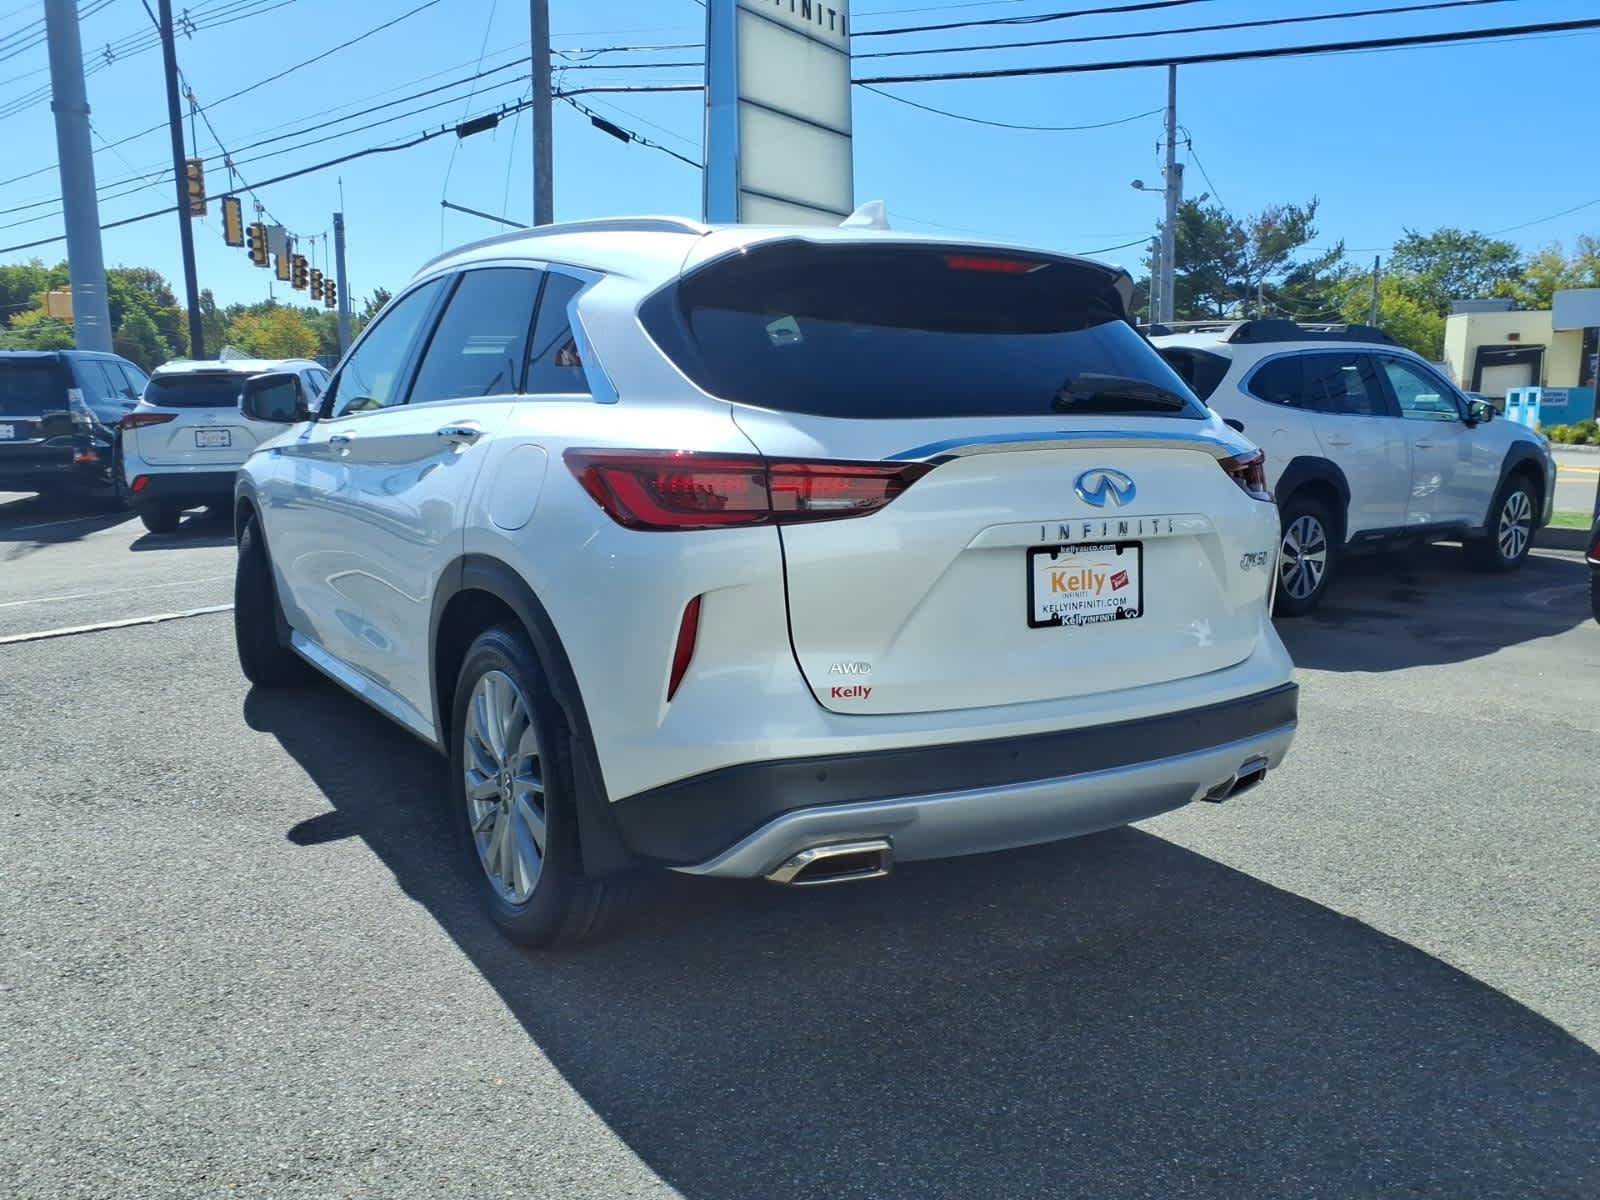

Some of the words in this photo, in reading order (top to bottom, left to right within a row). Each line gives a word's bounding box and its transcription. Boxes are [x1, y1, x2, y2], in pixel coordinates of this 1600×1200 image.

[775, 0, 846, 37] INITI
[1041, 519, 1174, 541] INFINITI
[1051, 569, 1106, 596] Kelly
[1042, 597, 1127, 614] KELLYINFINITI.COM
[827, 661, 872, 674] AWD
[831, 685, 873, 700] Kelly
